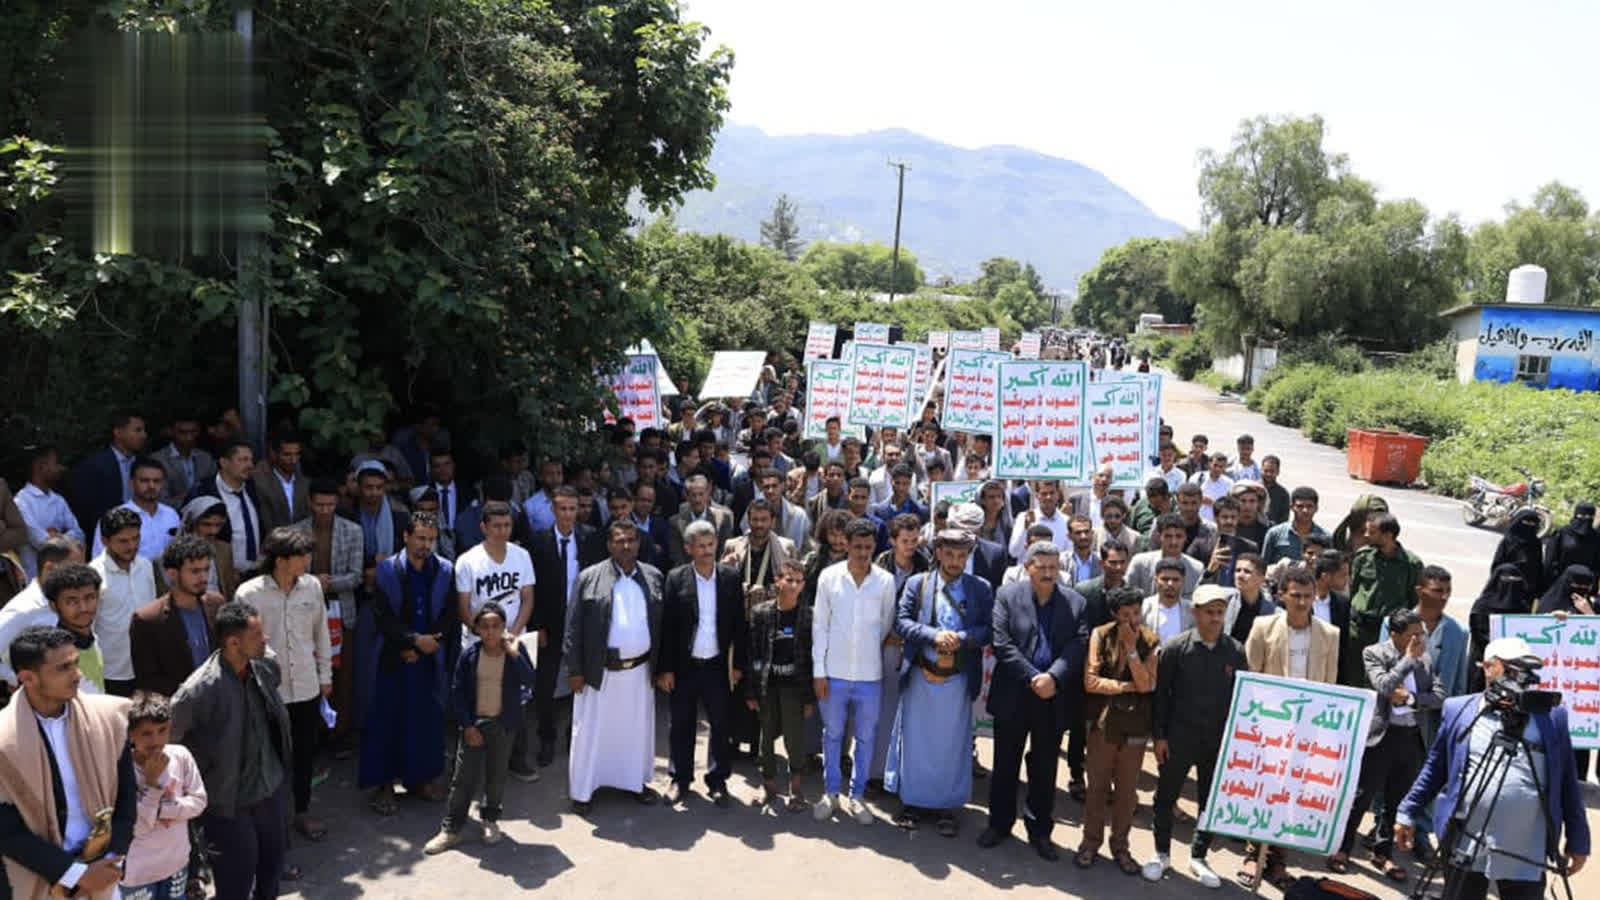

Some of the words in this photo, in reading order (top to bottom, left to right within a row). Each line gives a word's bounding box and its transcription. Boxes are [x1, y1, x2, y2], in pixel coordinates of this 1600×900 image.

[1004, 366, 1049, 391] أكبر
[1050, 368, 1080, 387] الله
[1046, 394, 1080, 409] الموت
[1046, 414, 1080, 430] الموت
[1108, 412, 1140, 426] الموت
[1002, 433, 1030, 448] اليهود
[1032, 436, 1048, 449] على
[1054, 432, 1079, 448] اللعنة
[1108, 431, 1140, 446] الموت
[1001, 452, 1040, 473] للإسلام
[1042, 451, 1079, 473] النصر
[476, 571, 520, 597] MADE
[1569, 625, 1597, 645] لله
[1563, 655, 1600, 670] لموت
[1562, 677, 1600, 693] لموت
[1239, 693, 1312, 723] أكبر
[1311, 703, 1355, 730] الله
[1296, 738, 1347, 760] الموت
[1291, 766, 1342, 788] الموت
[1221, 779, 1264, 801] اليهود
[1265, 787, 1290, 805] على
[1296, 790, 1335, 813] اللعنة
[1215, 801, 1273, 834] للإسلام
[1274, 814, 1328, 840] النصر
